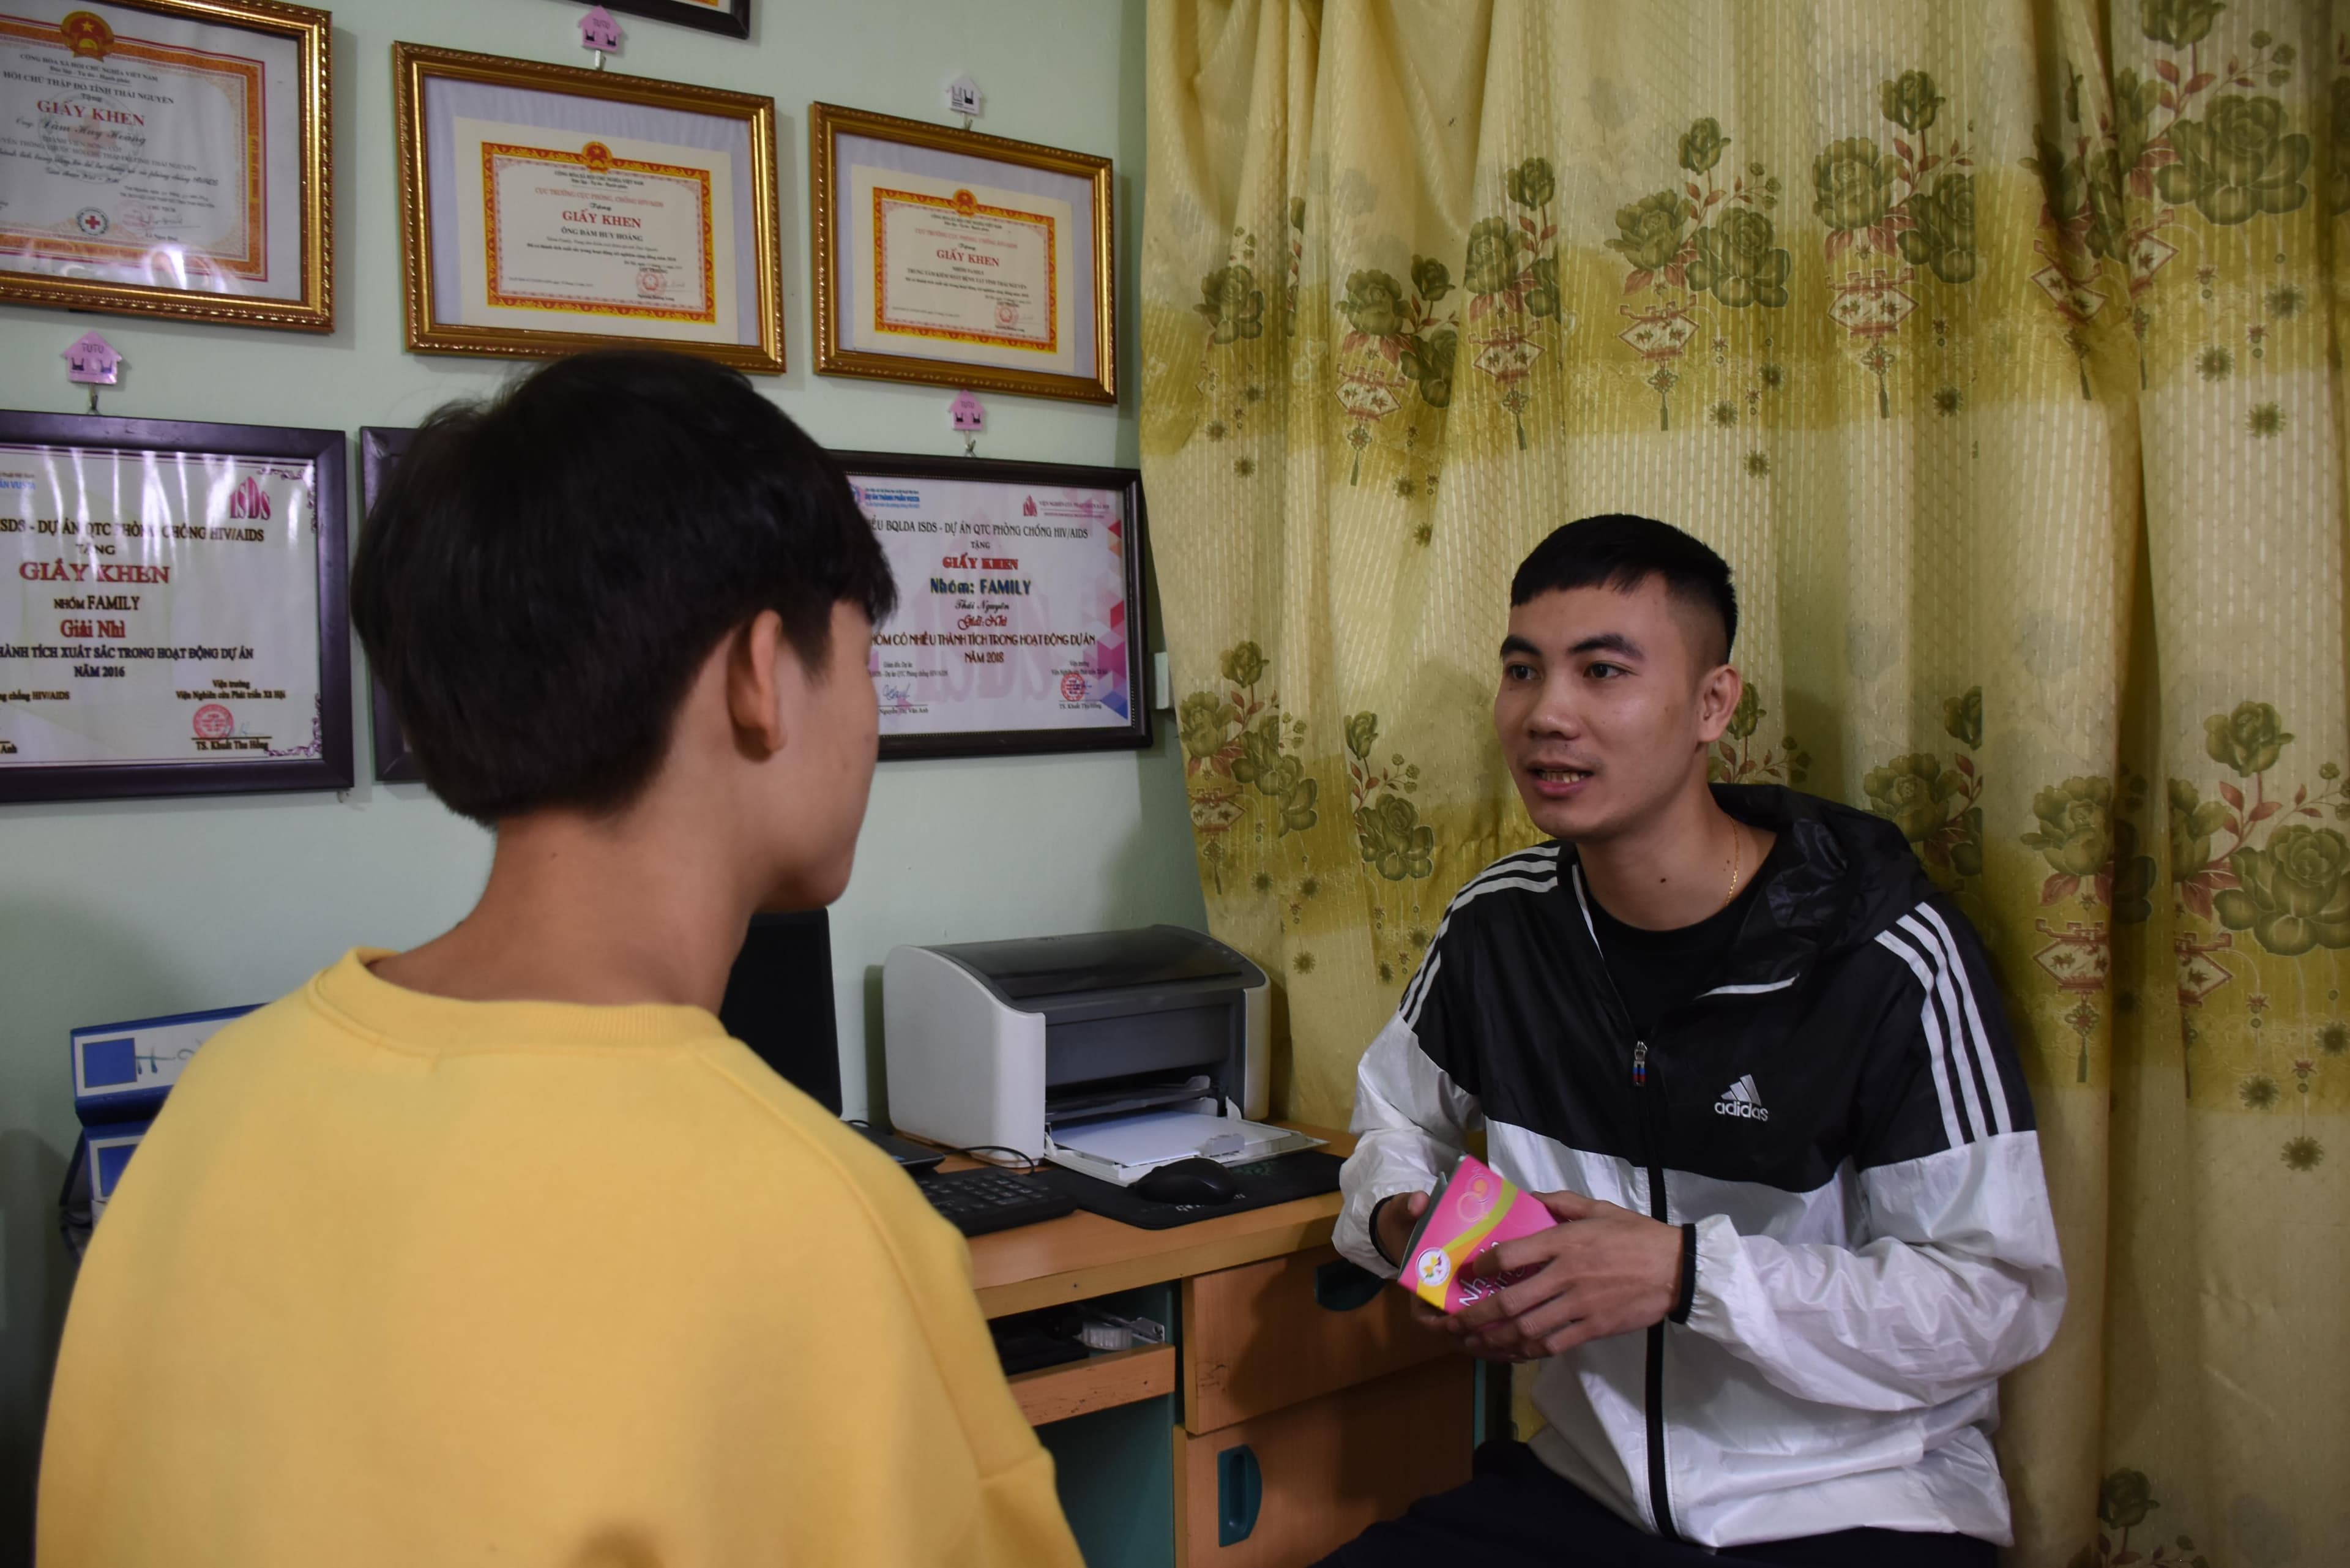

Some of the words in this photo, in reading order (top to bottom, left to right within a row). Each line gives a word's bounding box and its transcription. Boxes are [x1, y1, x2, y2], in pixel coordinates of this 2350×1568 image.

[37, 99, 86, 118] GIẤY
[92, 107, 145, 127] KHEN
[562, 208, 597, 224] GIẤY
[602, 214, 642, 229] KHEN
[936, 247, 964, 261] GIẤY
[968, 254, 999, 267] KHEN
[229, 476, 271, 521] ISDS
[38, 520, 59, 537] DỰ
[209, 526, 264, 542] HIV/AIDS
[887, 520, 916, 533] BQLDA
[918, 521, 937, 533] ISDS
[945, 521, 958, 536] DỰ
[960, 520, 971, 534] ÁN
[974, 523, 991, 536] QTC
[993, 521, 1021, 537] PHÒNG
[1023, 522, 1052, 538] CHỐNG
[1054, 528, 1088, 540] HIV/AIDS
[971, 541, 990, 550] TẶNG
[942, 552, 978, 569] GIẤY
[19, 558, 89, 582] GIẤY
[95, 564, 170, 583] KHEN
[930, 577, 974, 595] Nhóm:
[980, 578, 1031, 596] FAMILY
[54, 597, 84, 610] NHÓM
[87, 595, 140, 611] FAMILY
[60, 619, 94, 638] Giải
[871, 632, 891, 646] HÓM
[893, 632, 908, 646] CÓ
[910, 631, 936, 646] NHIỀU
[938, 632, 966, 646] THÀNH
[968, 632, 987, 646] TÍCH
[989, 634, 1018, 646] TRONG
[1020, 634, 1043, 646] HOẠT
[1044, 633, 1069, 646] ĐỘNG
[1070, 633, 1083, 646] DỰ
[1084, 632, 1095, 646] ÁN
[31, 644, 58, 659] TÍCH
[61, 644, 92, 659] XUẤT
[94, 644, 115, 659] SẮC
[118, 647, 154, 660] TRONG
[157, 648, 187, 662] HOẠT
[188, 645, 218, 662] ĐỘNG
[221, 647, 237, 662] DỰ
[239, 646, 254, 660] ÁN
[964, 650, 984, 663] NĂM
[987, 651, 1004, 663] 2018
[74, 663, 100, 678] NĂM
[102, 665, 125, 678] 2016
[32, 691, 70, 701] HIV/AIDS
[1714, 1101, 1769, 1122] adidas
